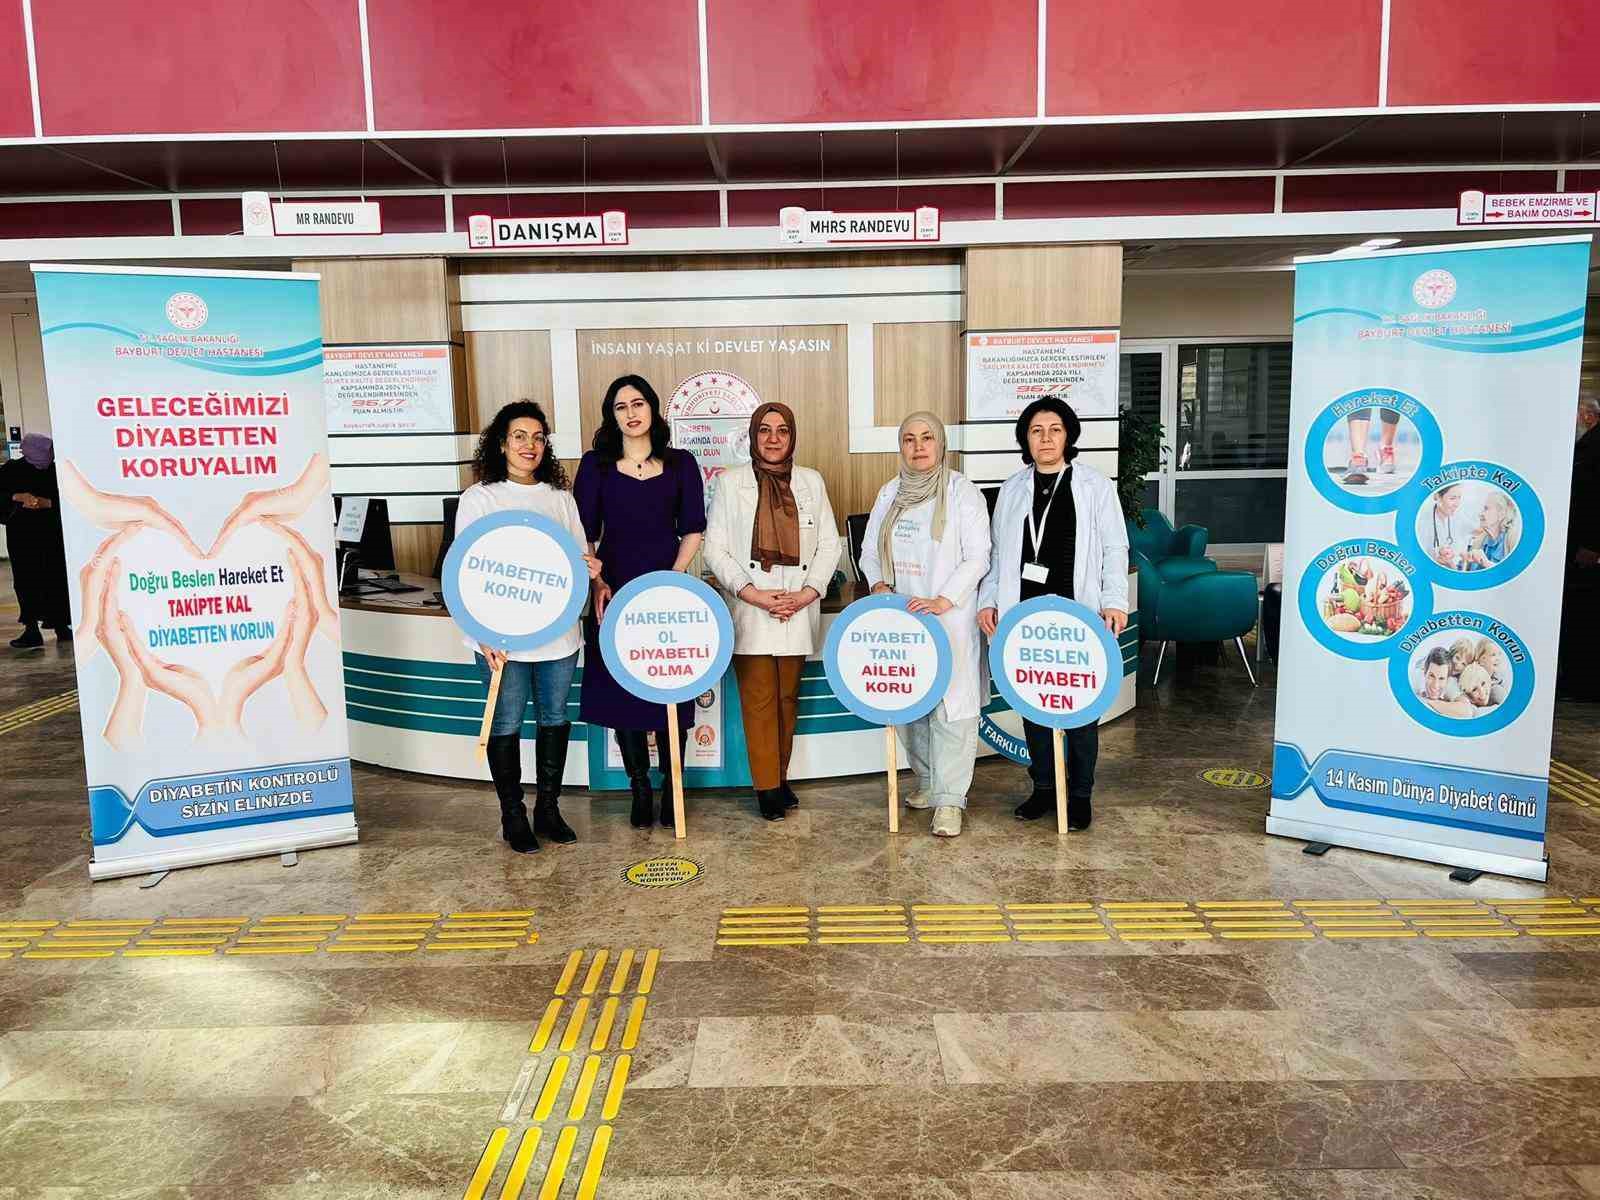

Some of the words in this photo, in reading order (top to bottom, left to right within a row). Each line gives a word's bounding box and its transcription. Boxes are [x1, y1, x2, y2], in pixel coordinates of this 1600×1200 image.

[1491, 199, 1526, 207] BEBEK
[1528, 197, 1575, 206] EMZİRME
[1576, 198, 1589, 206] VE
[296, 213, 311, 224] MR
[313, 212, 354, 224] RANDEVU
[1507, 210, 1539, 218] BAKIM
[1541, 209, 1572, 218] ODASI
[499, 222, 598, 242] DANIŞMA
[810, 220, 847, 233] MHRS
[850, 220, 910, 233] RANDEVU
[115, 346, 162, 358] BAYBURT
[167, 347, 204, 358] DEVLET
[646, 342, 692, 357] YAŞAT
[714, 340, 764, 353] DEVLET
[768, 339, 832, 355] YAŞASIN
[97, 392, 289, 416] GELECEĞİMİZİ
[1332, 392, 1397, 418] Hareket
[1401, 399, 1418, 417] Et
[116, 424, 277, 448] DİYABETTEN
[703, 448, 720, 457] OLUN
[121, 456, 277, 478] KORUYALIM
[1423, 465, 1487, 490] Takipte
[1492, 470, 1521, 492] Kal
[1316, 545, 1360, 570] Doğru
[1367, 542, 1414, 575] Beslen
[128, 570, 168, 594] Doğru
[172, 570, 215, 588] Beslen
[218, 566, 268, 586] Hareket
[271, 566, 284, 583] Et
[468, 555, 568, 589] DİYABETTEN
[484, 580, 543, 604] KORUN
[168, 594, 223, 618] TAKİPTE
[226, 595, 252, 613] KAL
[624, 608, 708, 626] HAREKETLİ
[148, 624, 227, 648] DİYABETTEN
[231, 621, 275, 640] KORUN
[658, 630, 678, 644] OL
[851, 629, 926, 644] DİYABETİ
[1021, 622, 1086, 642] DOĞRU
[1400, 614, 1482, 652] Diyabetten
[1488, 622, 1526, 662] Korun
[630, 644, 710, 660] DİYABETLİ
[868, 649, 906, 660] TANI
[1020, 648, 1089, 666] BESLEN
[648, 664, 694, 676] OLMA
[862, 663, 916, 677] AİLENİ
[1016, 666, 1096, 688] DİYABETİ
[866, 682, 912, 694] KORU
[1038, 693, 1073, 710] YEN
[984, 726, 1018, 756] FARKLI
[150, 778, 243, 804] DİYABETİN
[248, 766, 338, 792] KONTROLÜ
[1326, 768, 1344, 788] 14
[1348, 772, 1388, 795] Kasım
[1392, 778, 1434, 804] Dünya
[1439, 786, 1494, 812] Diyabet
[1498, 794, 1536, 818] Günü
[181, 800, 229, 818] SİZİN
[234, 790, 313, 812] ELİNİZDE
